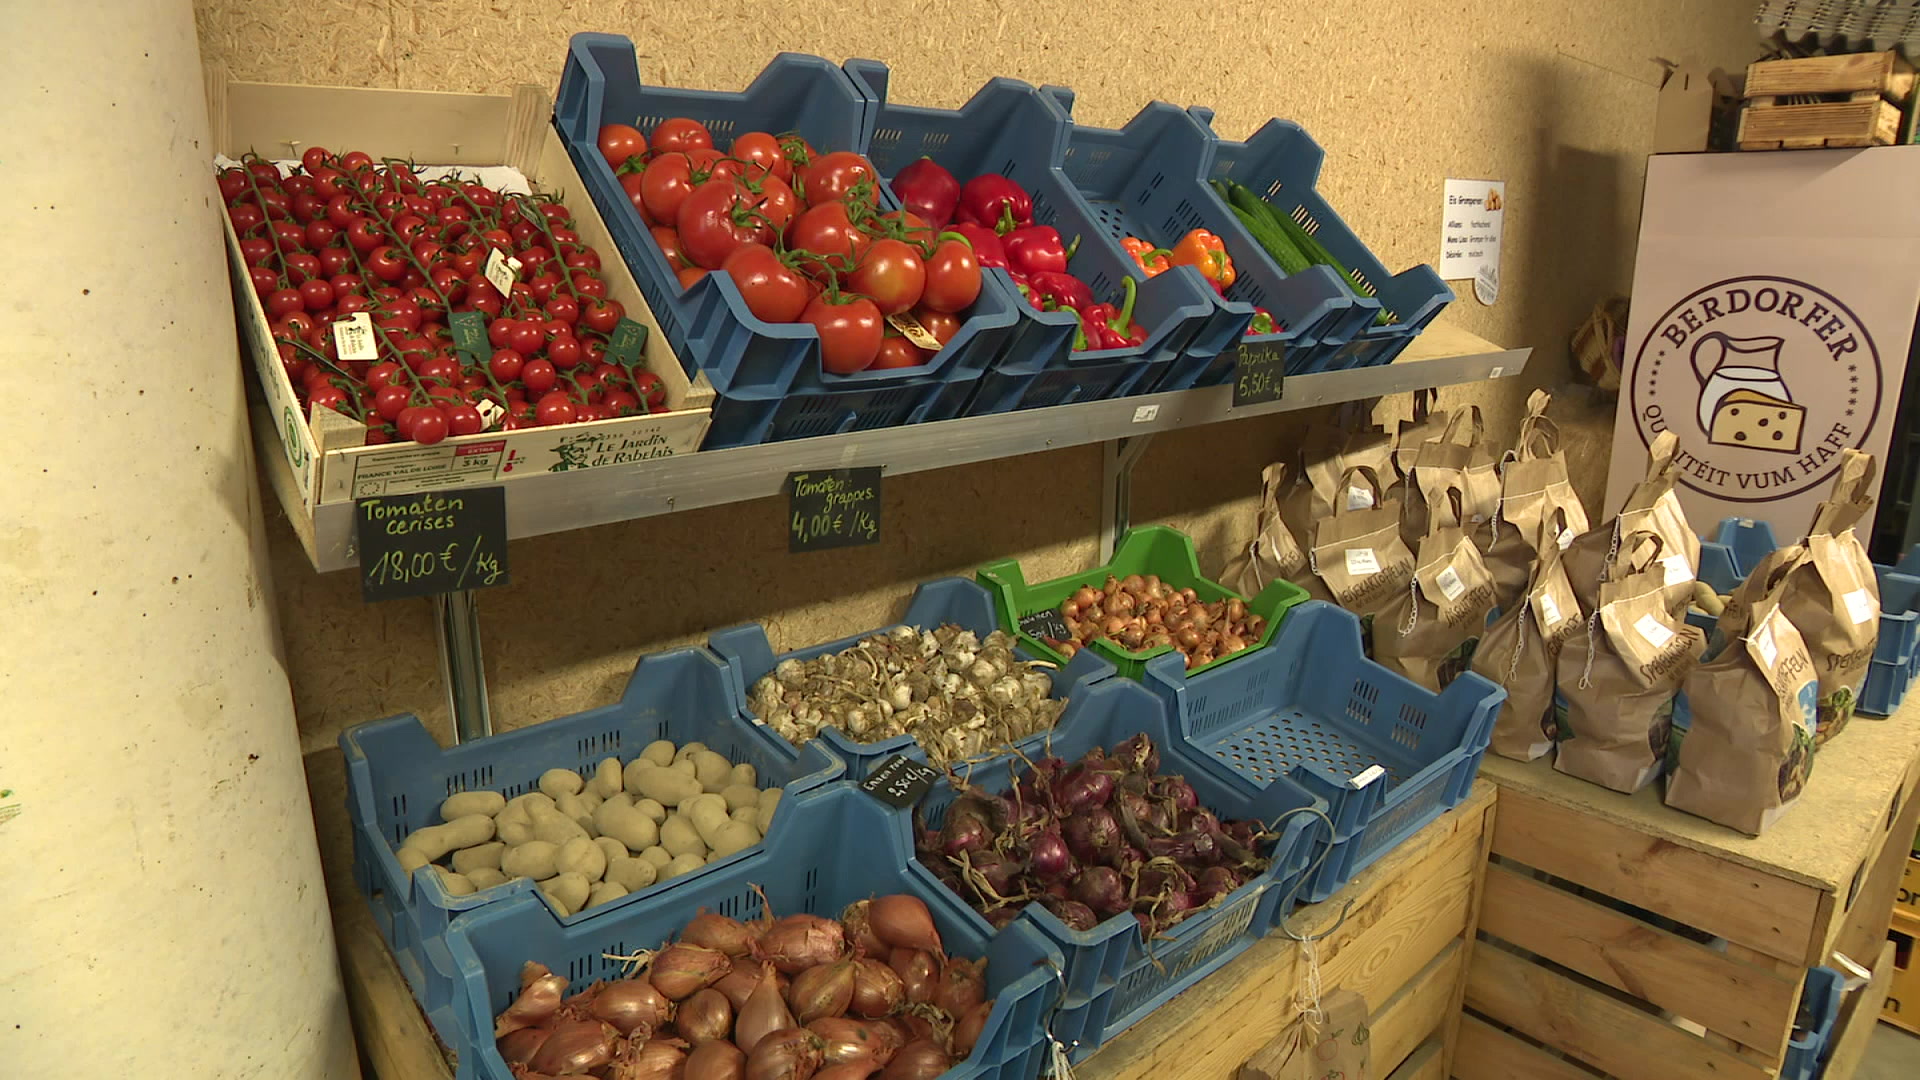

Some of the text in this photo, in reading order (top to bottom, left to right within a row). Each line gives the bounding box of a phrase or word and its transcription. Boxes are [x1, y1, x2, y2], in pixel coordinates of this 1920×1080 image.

[1661, 287, 1859, 361] BERDORFER
[1642, 404, 1852, 490] QUITÉIT VUM HAFF
[357, 471, 392, 479] FRANCE
[360, 494, 463, 520] Tomaten
[386, 515, 455, 535] cerises
